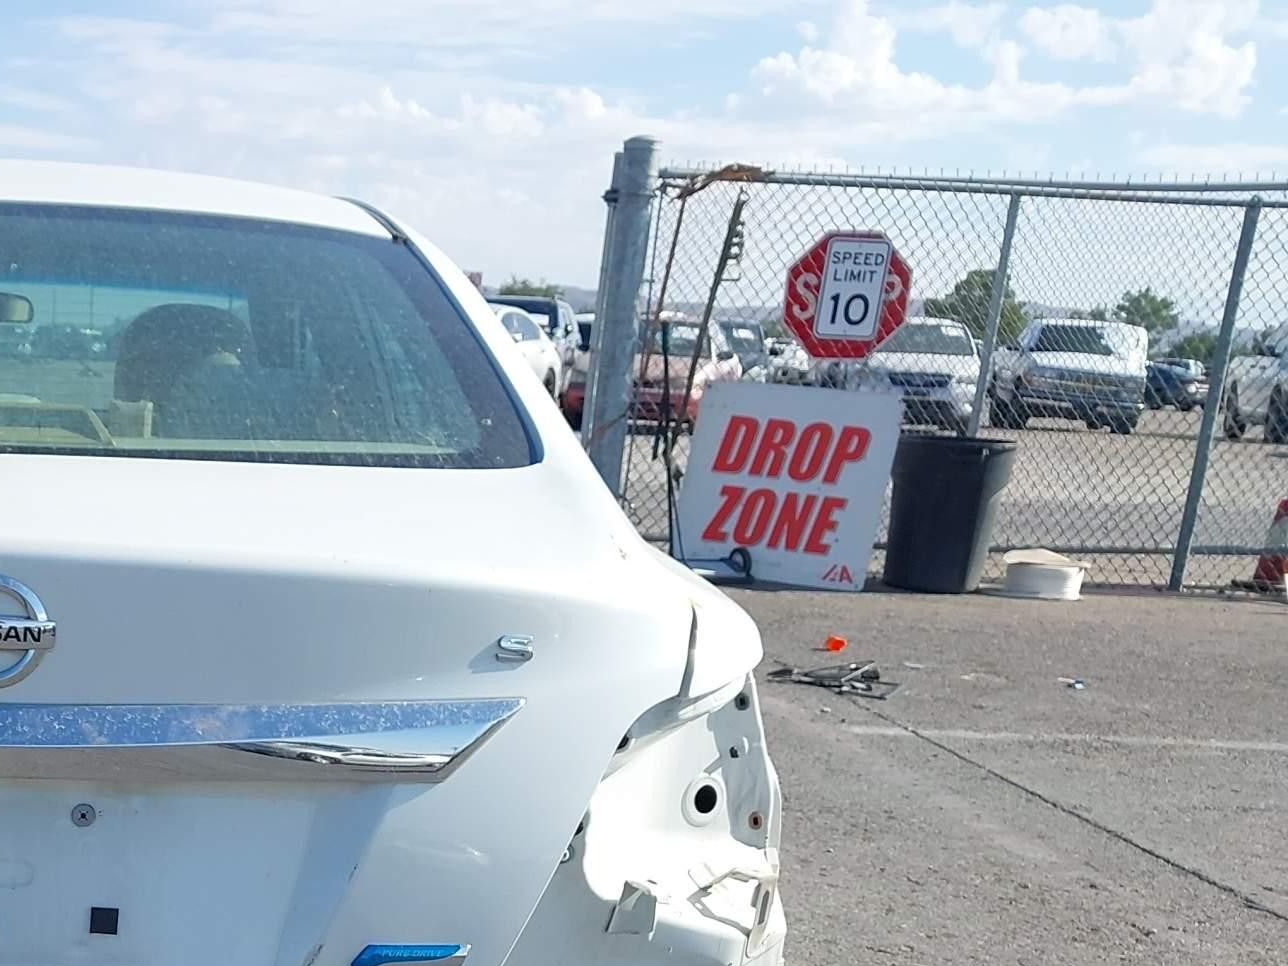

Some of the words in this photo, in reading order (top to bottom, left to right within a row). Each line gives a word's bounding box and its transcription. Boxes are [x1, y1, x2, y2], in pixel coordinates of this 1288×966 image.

[831, 250, 885, 266] SPEED
[833, 268, 878, 284] LIMIT
[829, 292, 870, 326] 10
[712, 414, 873, 486] DROP
[701, 484, 849, 556] ZONE
[495, 634, 534, 663] S
